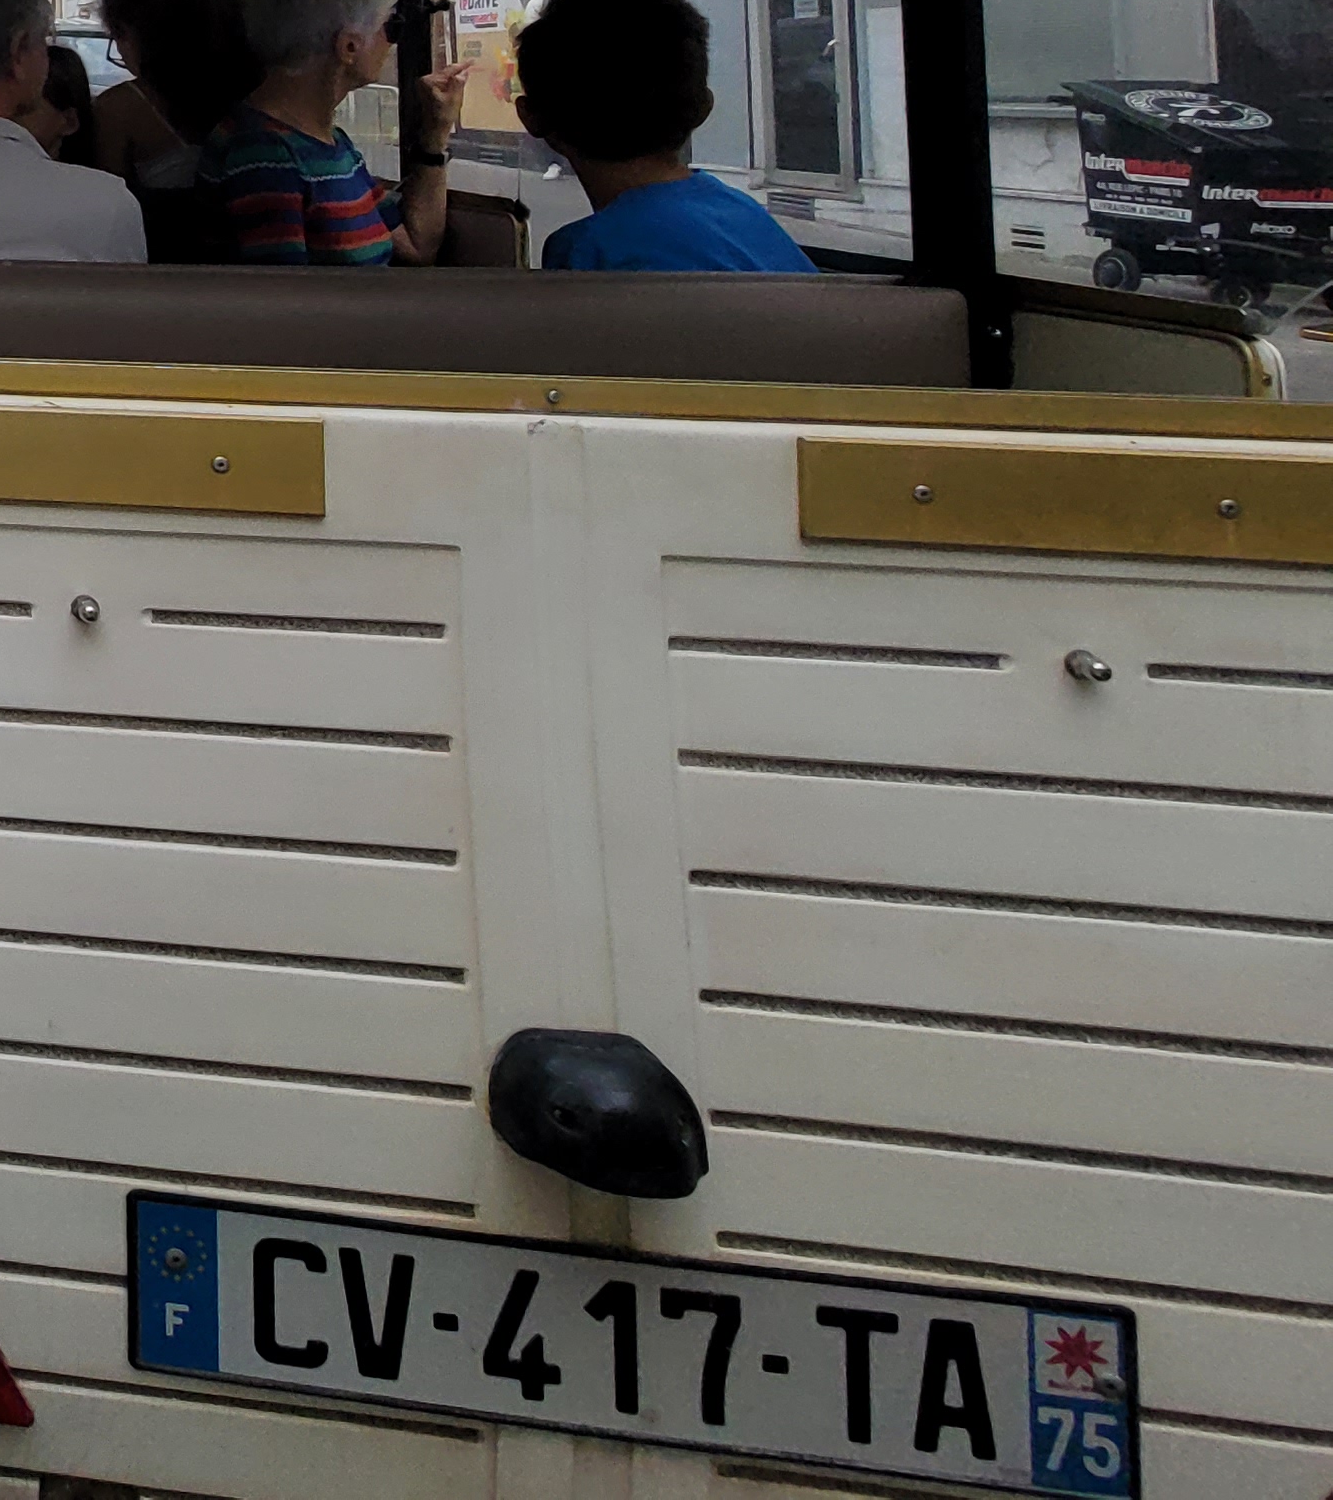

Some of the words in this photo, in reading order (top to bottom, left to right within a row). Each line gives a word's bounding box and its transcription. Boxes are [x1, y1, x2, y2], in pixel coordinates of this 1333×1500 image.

[164, 1303, 189, 1337] F
[252, 1237, 997, 1462] CV-417-TA
[1037, 1406, 1121, 1478] 75
